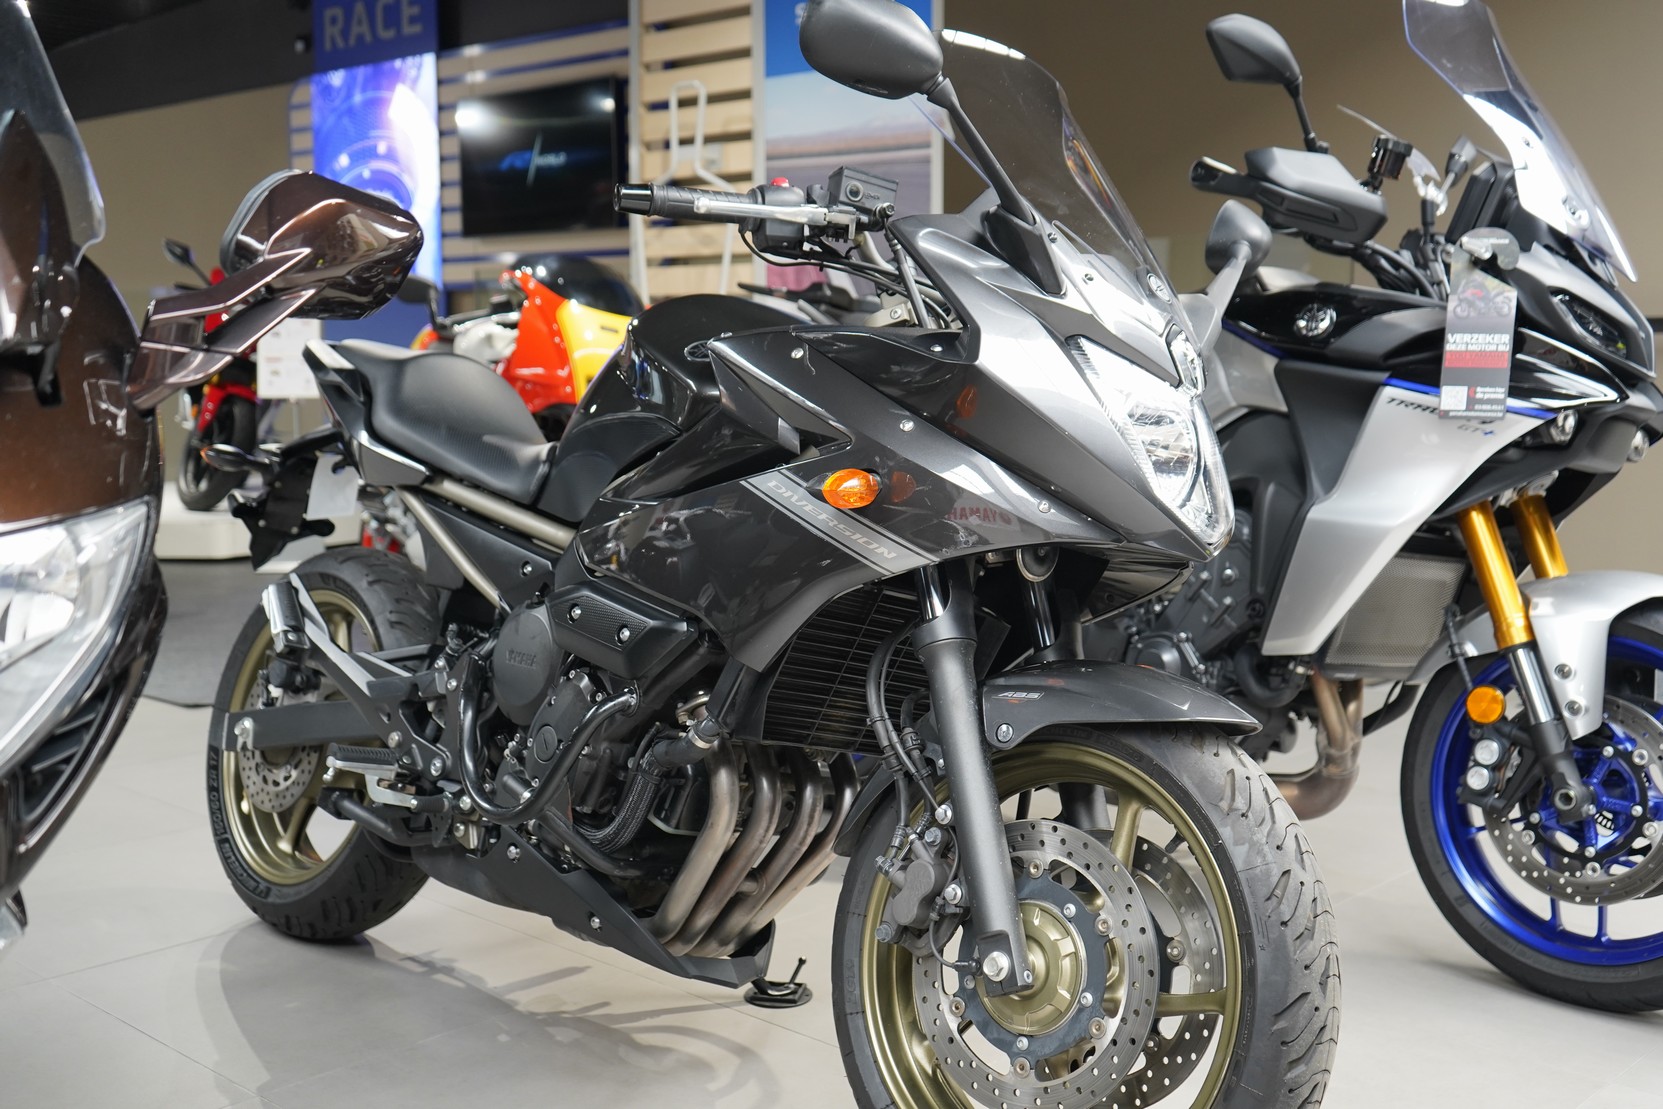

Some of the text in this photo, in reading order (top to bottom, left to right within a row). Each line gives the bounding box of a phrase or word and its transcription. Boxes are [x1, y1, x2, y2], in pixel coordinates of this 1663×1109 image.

[323, 0, 424, 51] RACE
[1447, 333, 1510, 344] VERZEKER
[1468, 343, 1497, 352] MOTOR
[767, 480, 897, 559] DIVERSION
[997, 691, 1042, 699] ABS
[208, 751, 217, 767] 17
[208, 769, 218, 788] ZR
